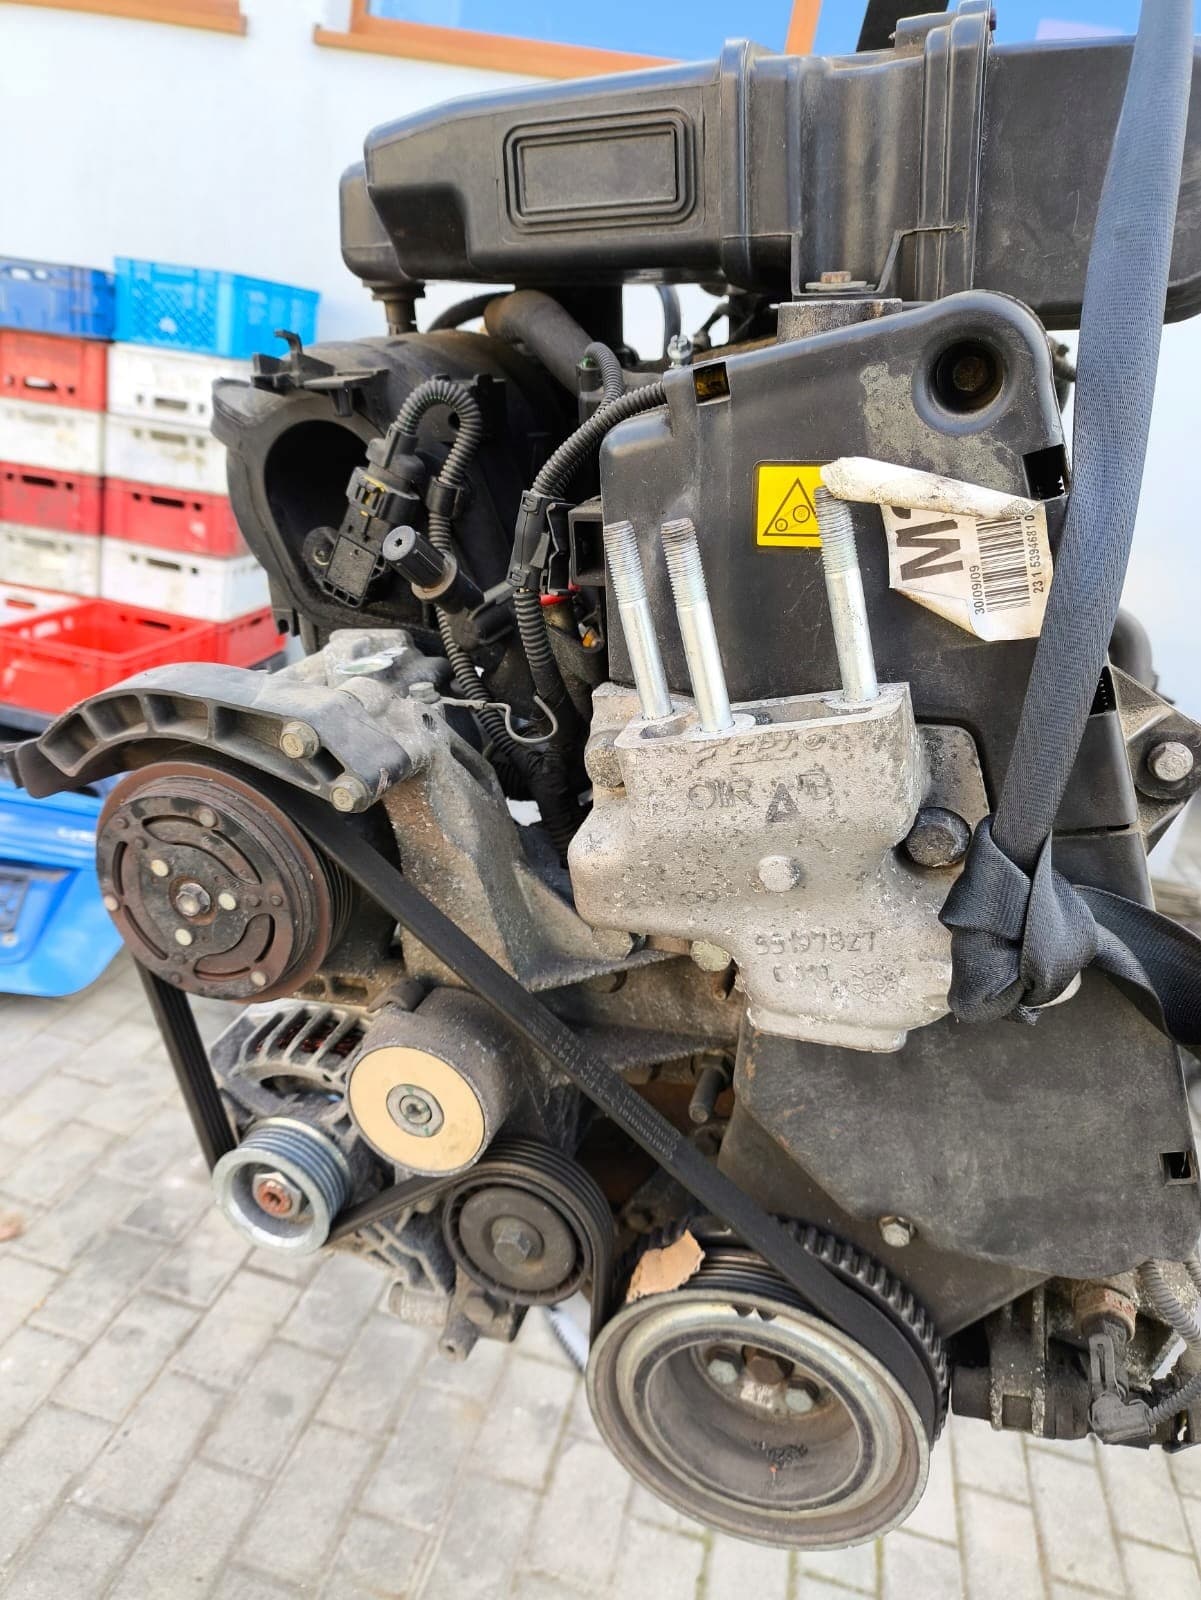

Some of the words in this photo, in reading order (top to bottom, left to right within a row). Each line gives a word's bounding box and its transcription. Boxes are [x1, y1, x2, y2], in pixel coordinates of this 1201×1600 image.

[892, 507, 964, 581] M
[1025, 525, 1041, 568] 5394681
[969, 565, 985, 615] 30/09/09
[1032, 571, 1042, 580] 1
[1033, 580, 1044, 594] 23
